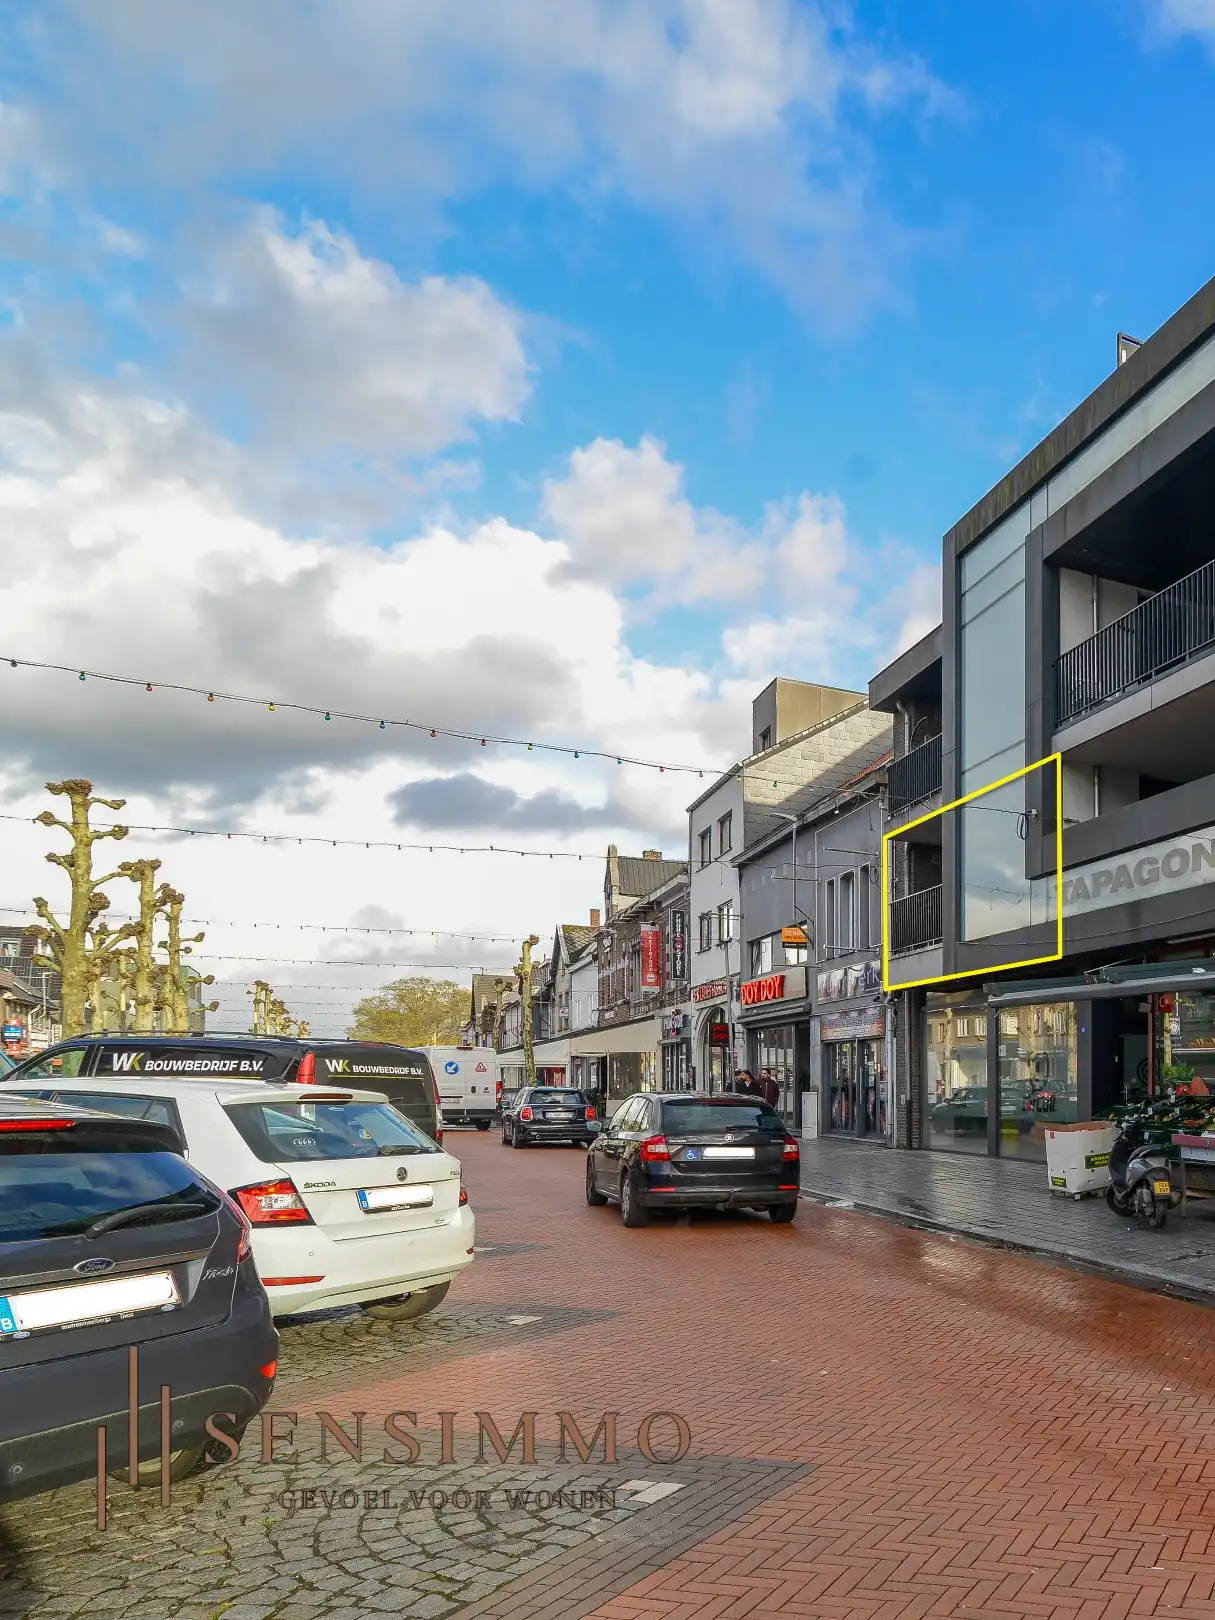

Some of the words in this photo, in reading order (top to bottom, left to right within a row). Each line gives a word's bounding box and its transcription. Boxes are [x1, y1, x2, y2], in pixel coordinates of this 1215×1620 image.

[741, 982, 759, 1005] DOY
[760, 975, 784, 1001] DOY
[112, 1052, 145, 1071] WK
[145, 1059, 238, 1072] BOUWBEDRIJF
[240, 1059, 263, 1072] B.V.
[325, 1059, 350, 1073] WK
[353, 1065, 404, 1075] BOUWBEDRIJF
[404, 1067, 424, 1076] B.V.
[84, 1261, 107, 1271] Ford
[1, 1317, 13, 1331] B
